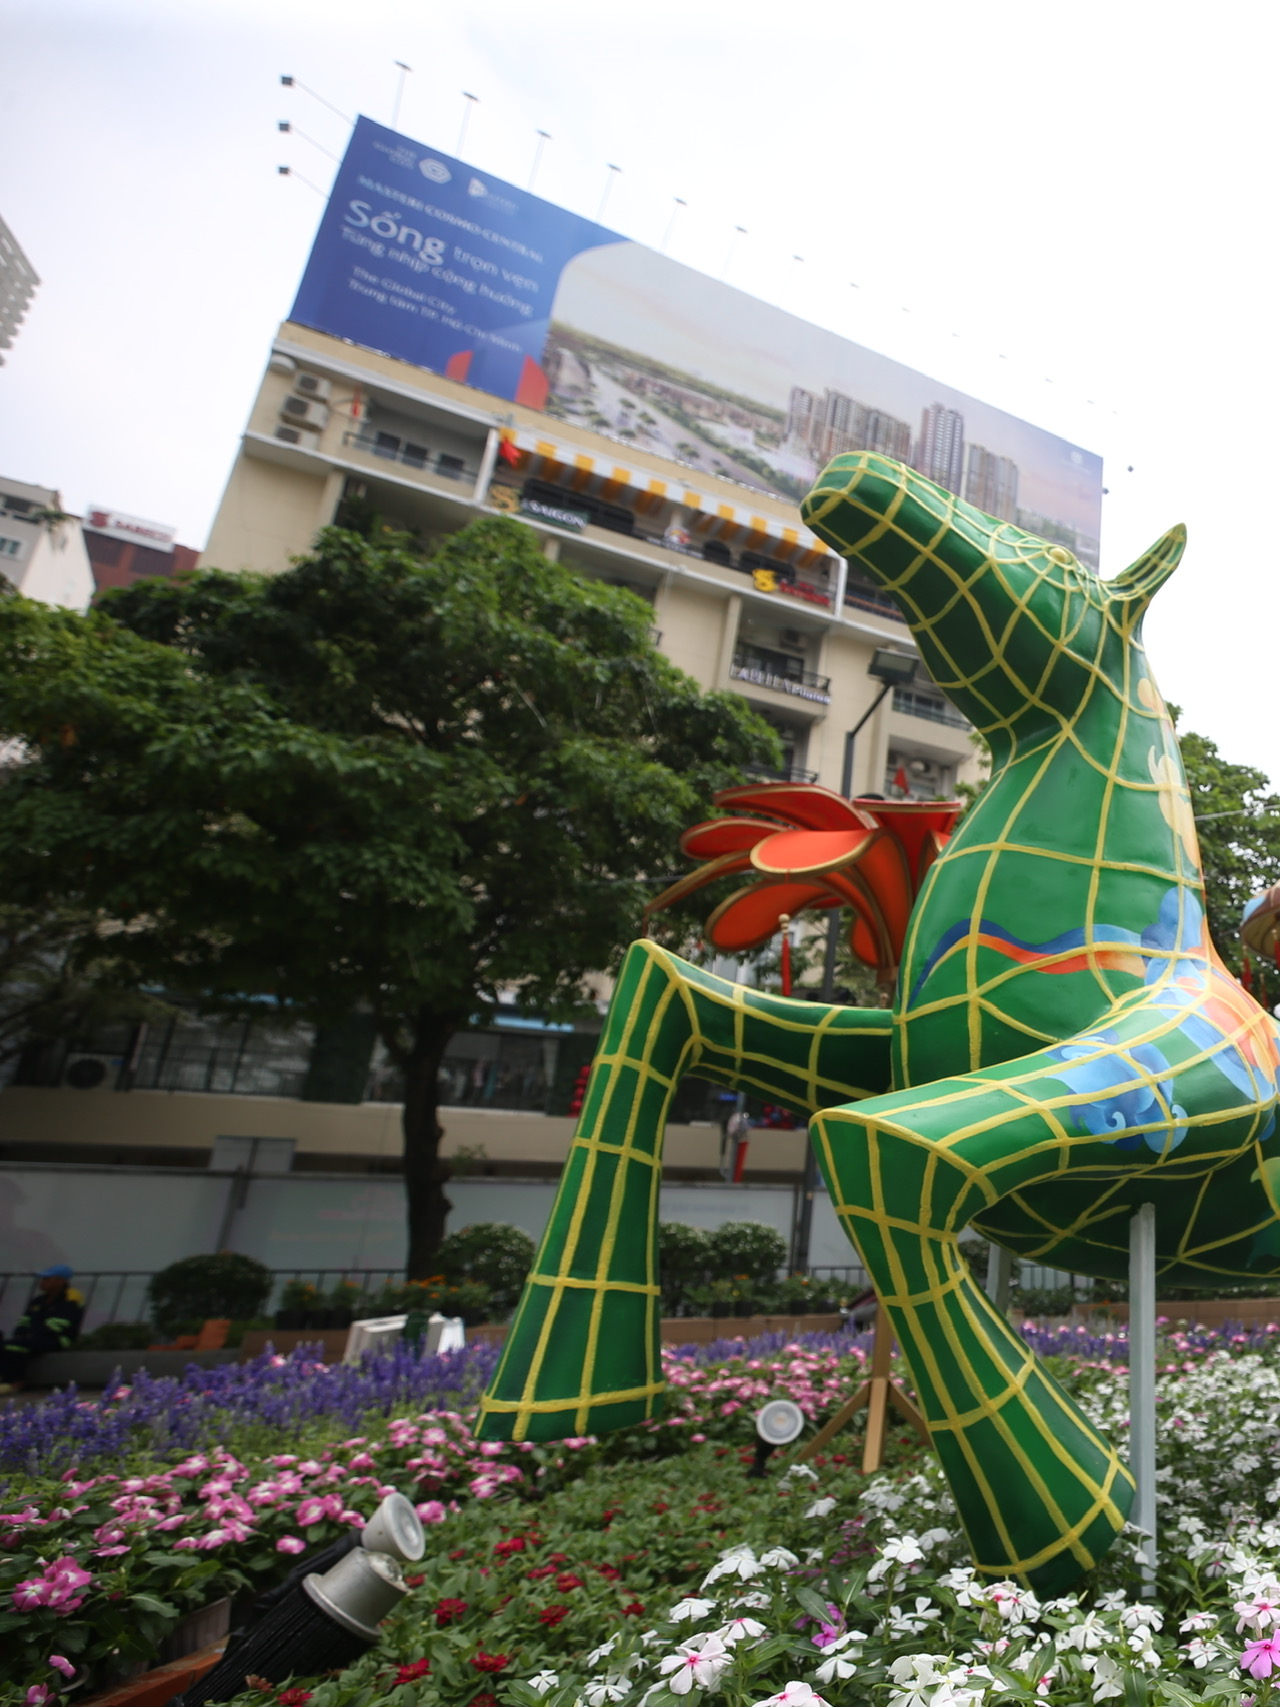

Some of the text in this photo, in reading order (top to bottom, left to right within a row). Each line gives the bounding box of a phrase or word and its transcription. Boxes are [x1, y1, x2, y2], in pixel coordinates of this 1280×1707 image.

[424, 203, 483, 236] COSMO
[343, 198, 540, 294] Sống trọn vẹn
[352, 265, 380, 285] The
[380, 277, 427, 302] Global
